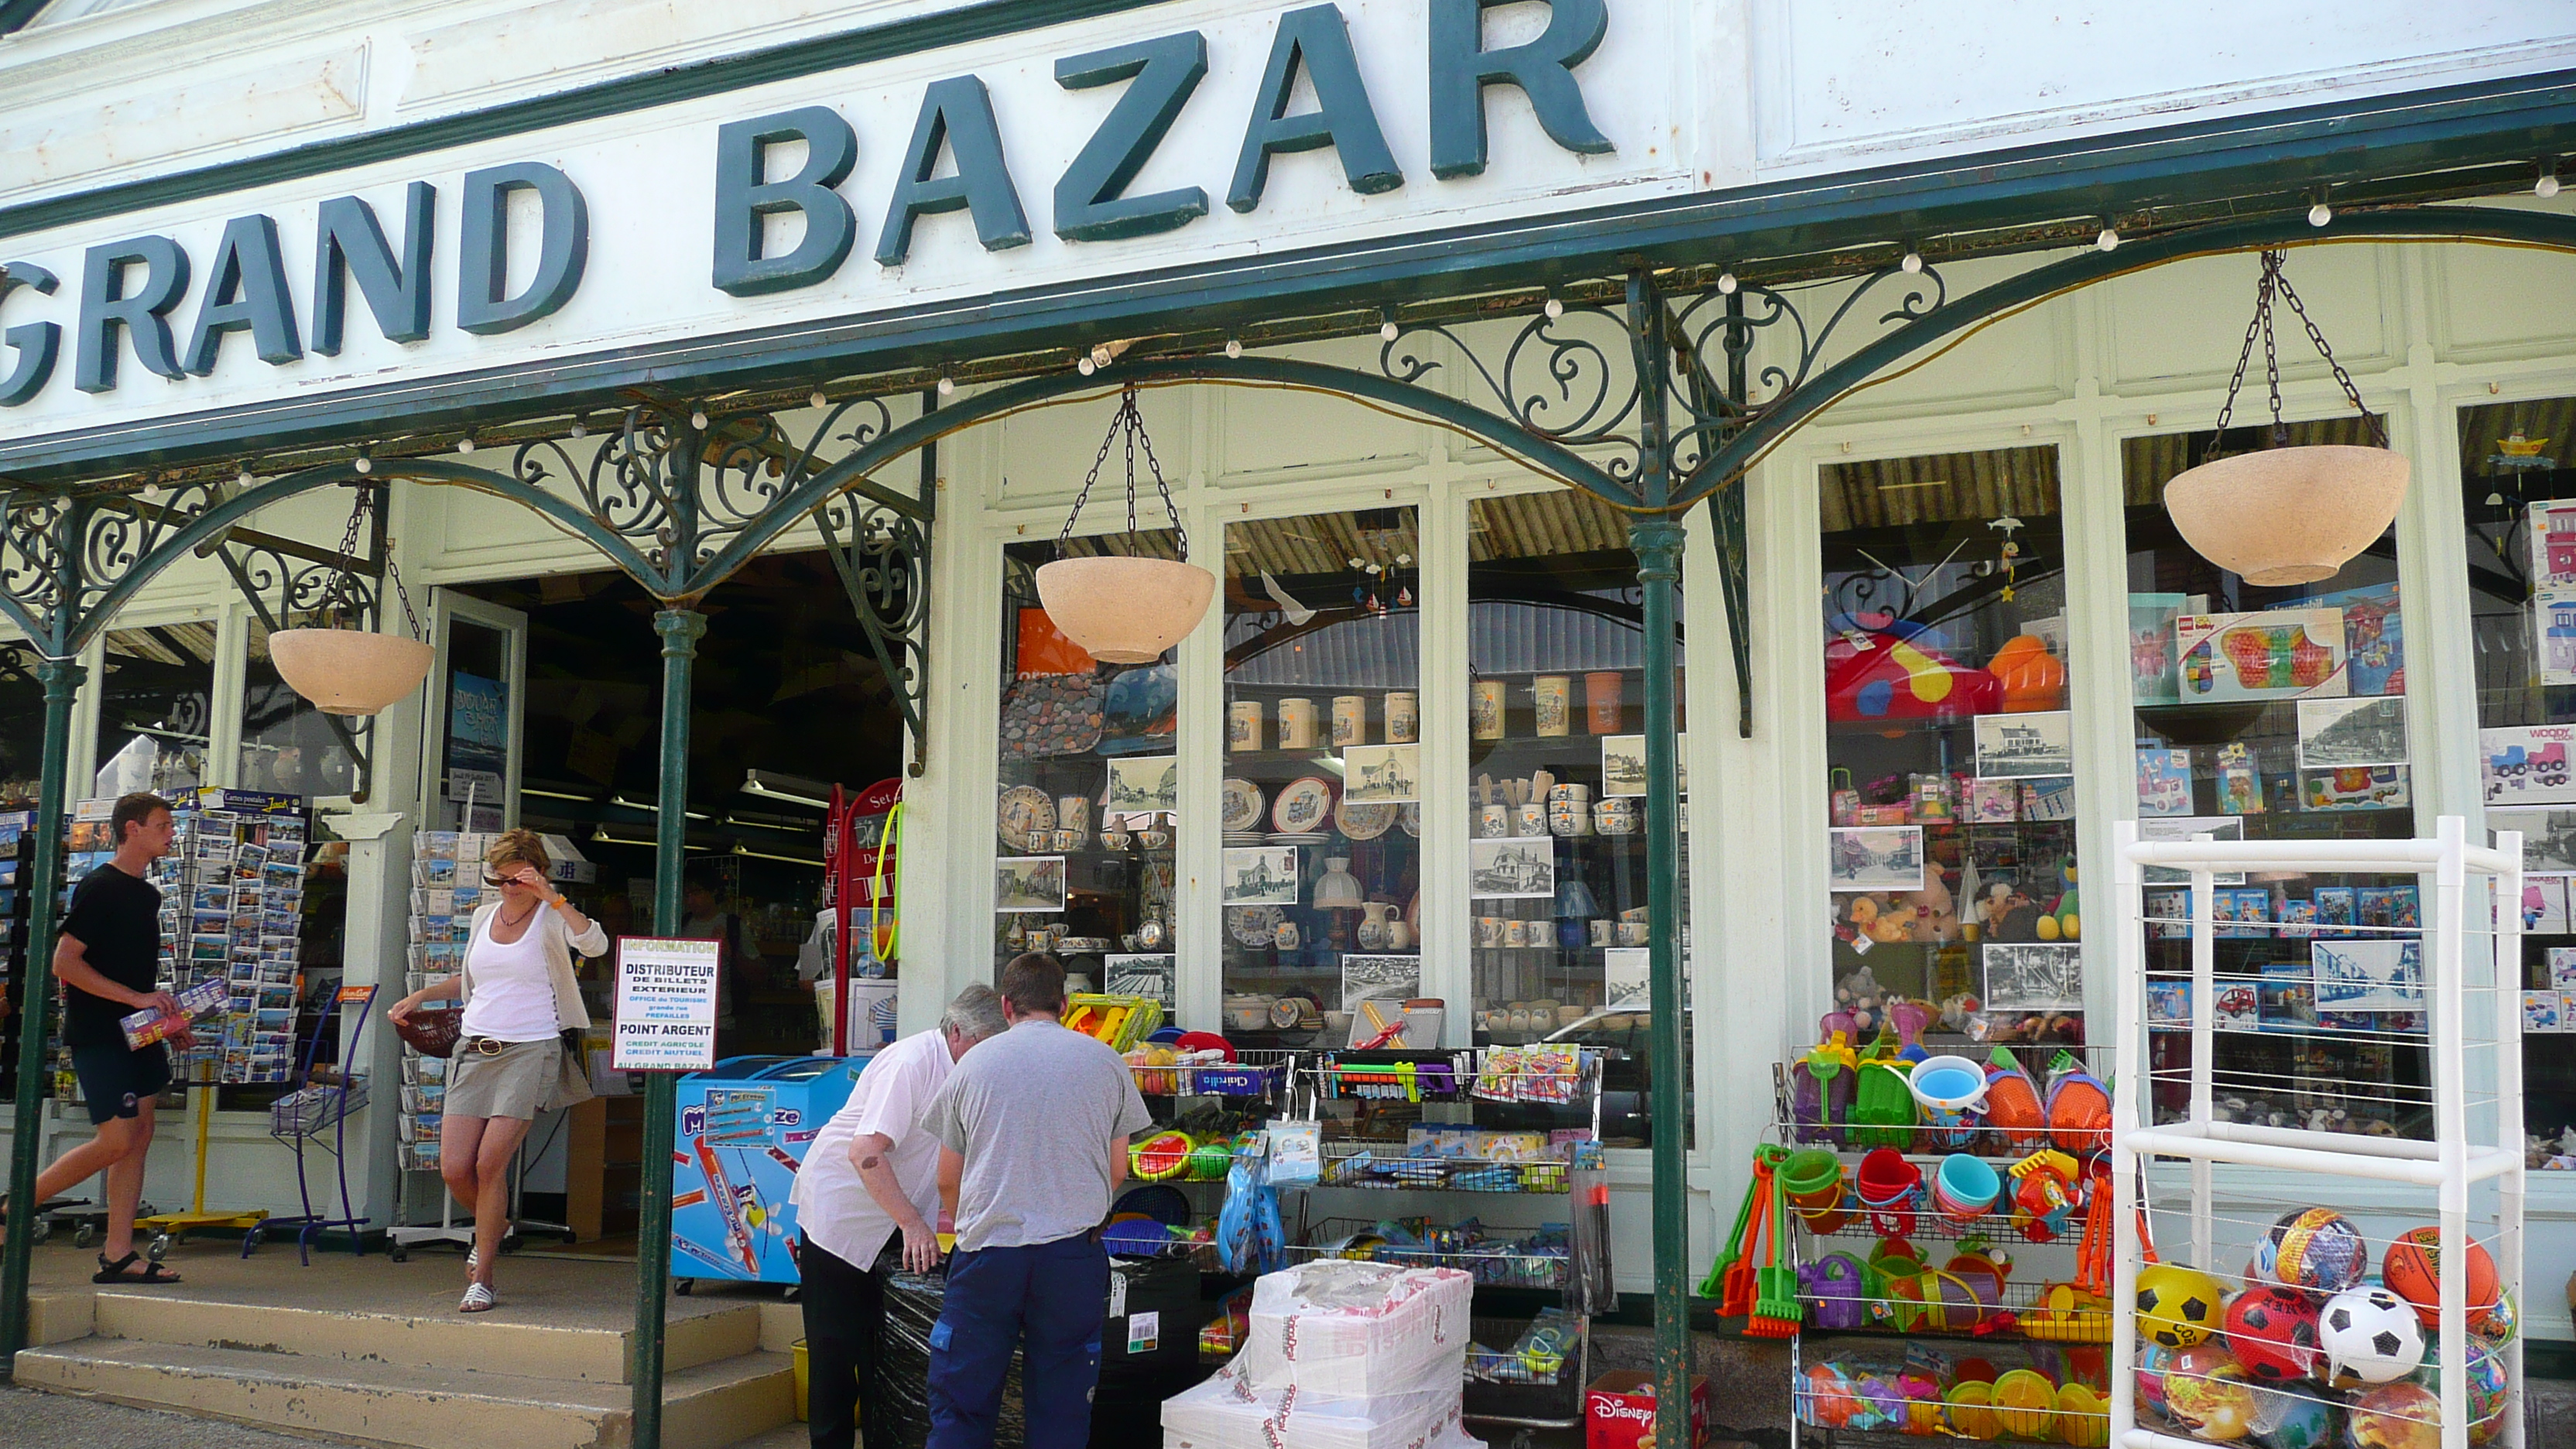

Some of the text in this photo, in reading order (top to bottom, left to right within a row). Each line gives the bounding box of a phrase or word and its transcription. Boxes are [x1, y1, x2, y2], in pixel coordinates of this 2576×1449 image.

[0, 0, 1616, 407] GRAND BAZAR
[2530, 728, 2570, 738] WOODY
[224, 793, 242, 802] Cartes
[244, 795, 265, 805] postales
[869, 793, 891, 808] Set
[623, 939, 717, 954] INFORMATION
[625, 964, 714, 978] DISTRIBUTEUR
[632, 985, 707, 994] EXTERIEUR
[619, 1024, 711, 1036] POINT ARGENT
